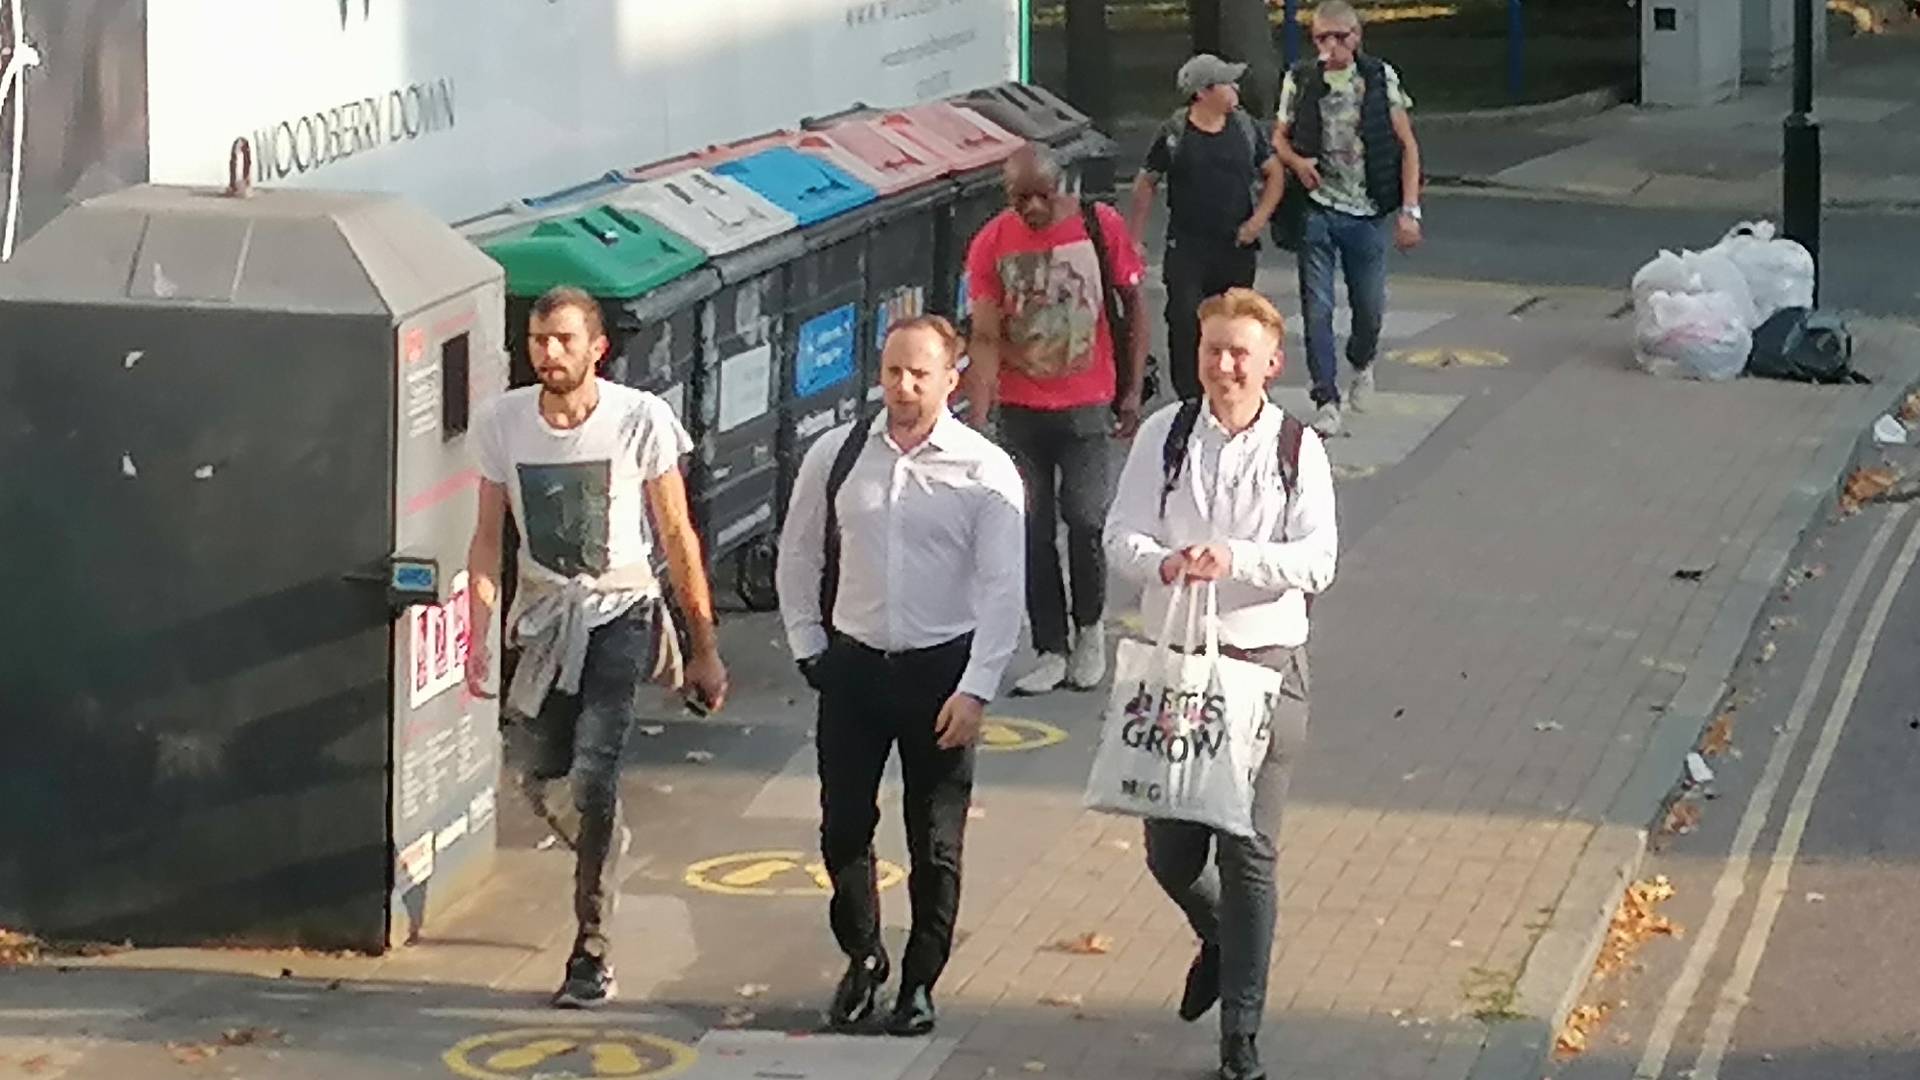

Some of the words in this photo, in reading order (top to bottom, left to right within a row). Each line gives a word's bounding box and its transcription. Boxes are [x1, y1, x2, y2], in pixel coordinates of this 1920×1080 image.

[253, 97, 382, 182] WOODBERRY
[389, 77, 455, 142] DOWN
[1121, 718, 1225, 763] GROW
